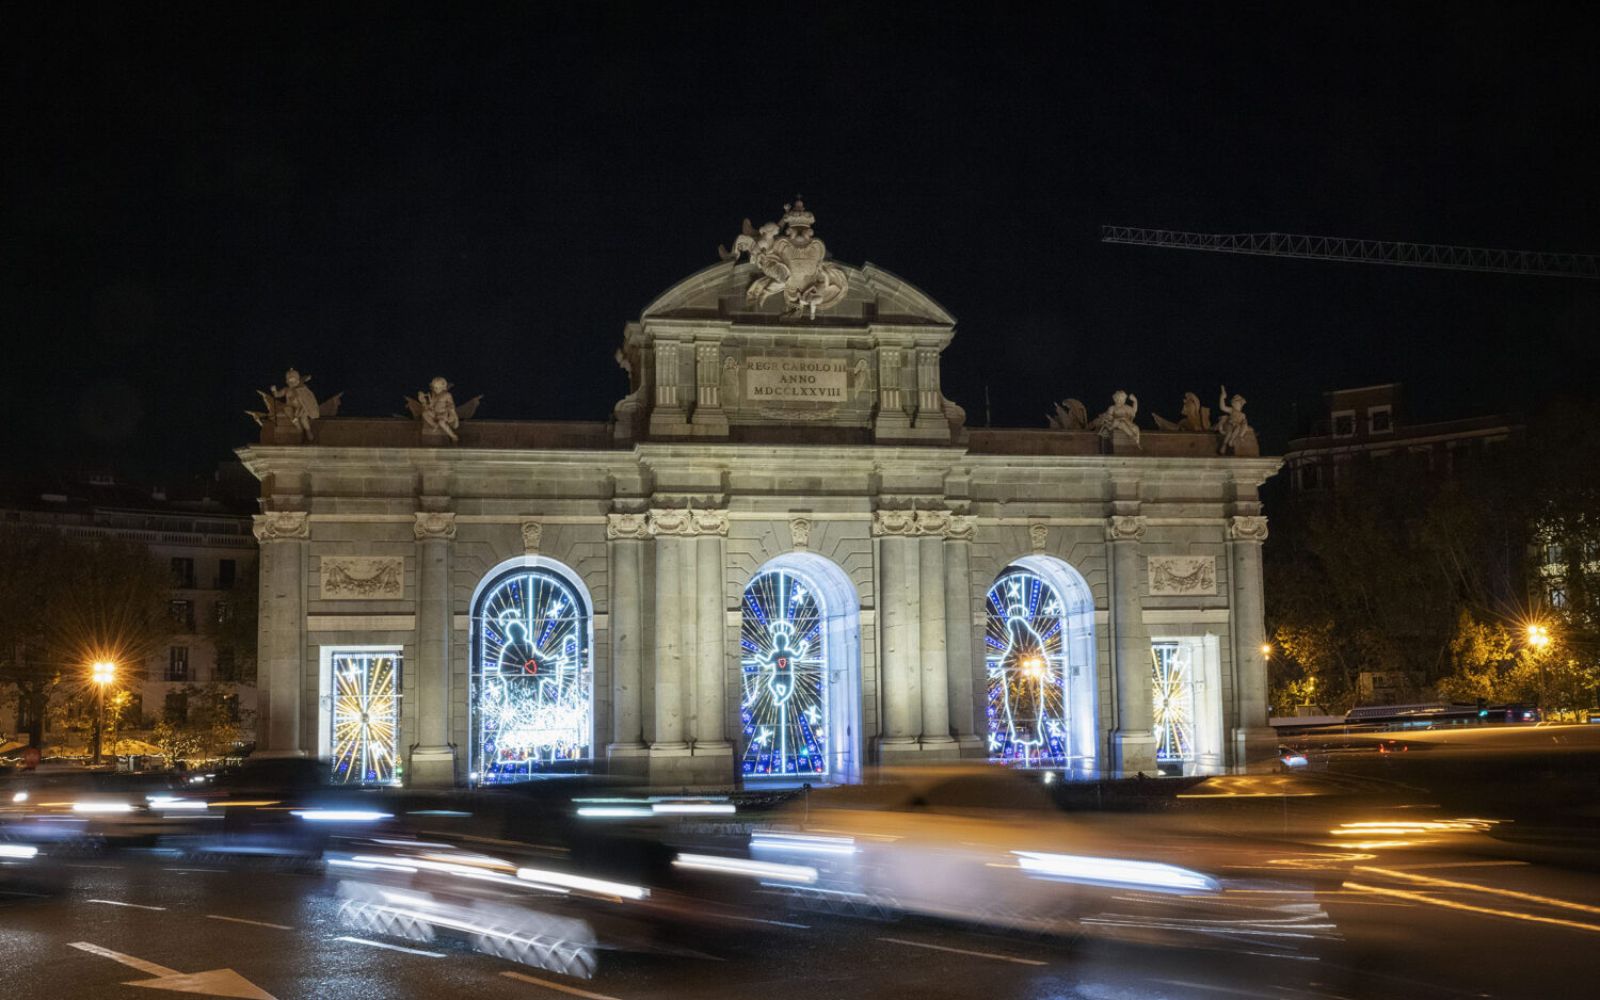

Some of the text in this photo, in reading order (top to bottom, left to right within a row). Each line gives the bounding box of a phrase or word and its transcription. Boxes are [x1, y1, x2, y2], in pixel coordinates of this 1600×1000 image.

[782, 363, 831, 372] CAROLO
[833, 364, 847, 372] III
[780, 375, 816, 384] ANNO
[754, 387, 841, 396] MDCCLXXVIII
